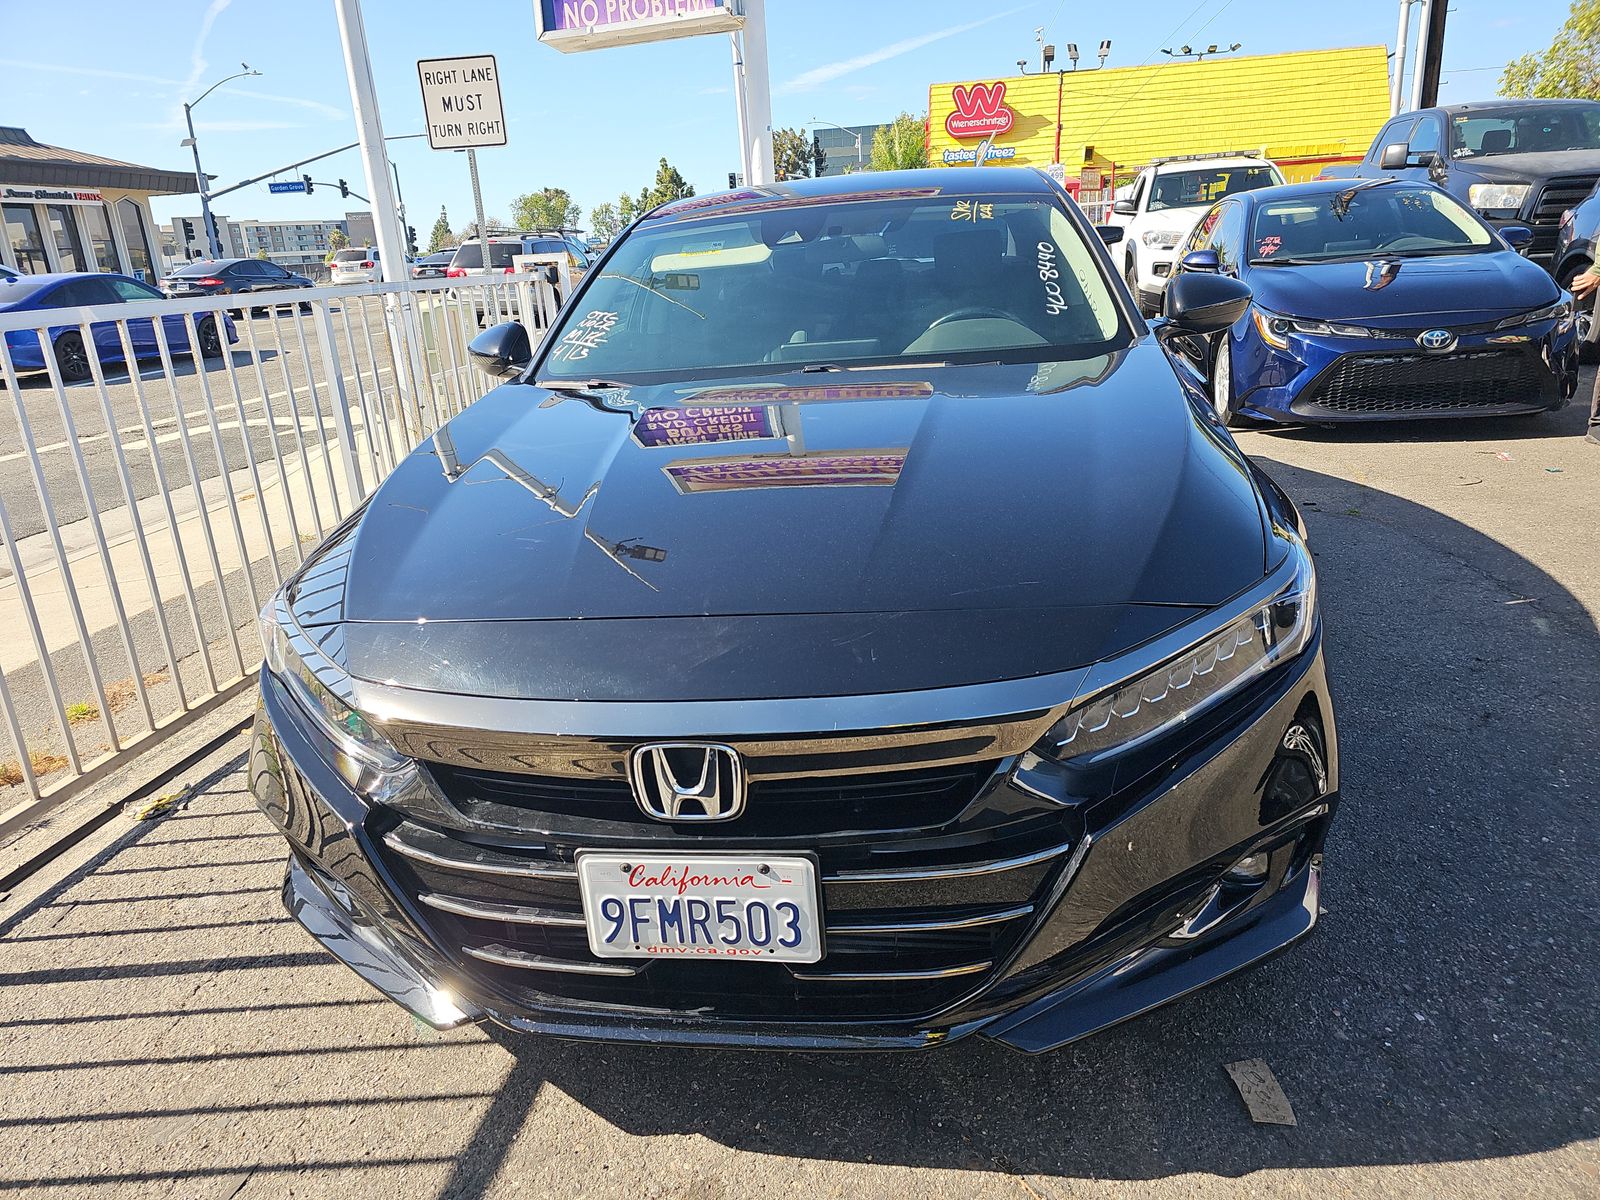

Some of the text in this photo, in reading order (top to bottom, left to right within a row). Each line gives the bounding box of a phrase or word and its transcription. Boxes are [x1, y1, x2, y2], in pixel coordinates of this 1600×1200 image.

[563, 0, 599, 29] NO
[424, 68, 493, 85] RIGHT LANE
[442, 94, 482, 112] MUST
[432, 121, 500, 137] TURN RIGHT
[951, 116, 1009, 129] Wienerschnitzel
[943, 145, 1016, 163] tastee freez
[75, 191, 104, 201] PAINTS
[628, 864, 771, 895] California
[601, 897, 802, 948] 9FMR503
[646, 945, 764, 957] dmv.ca.gov
